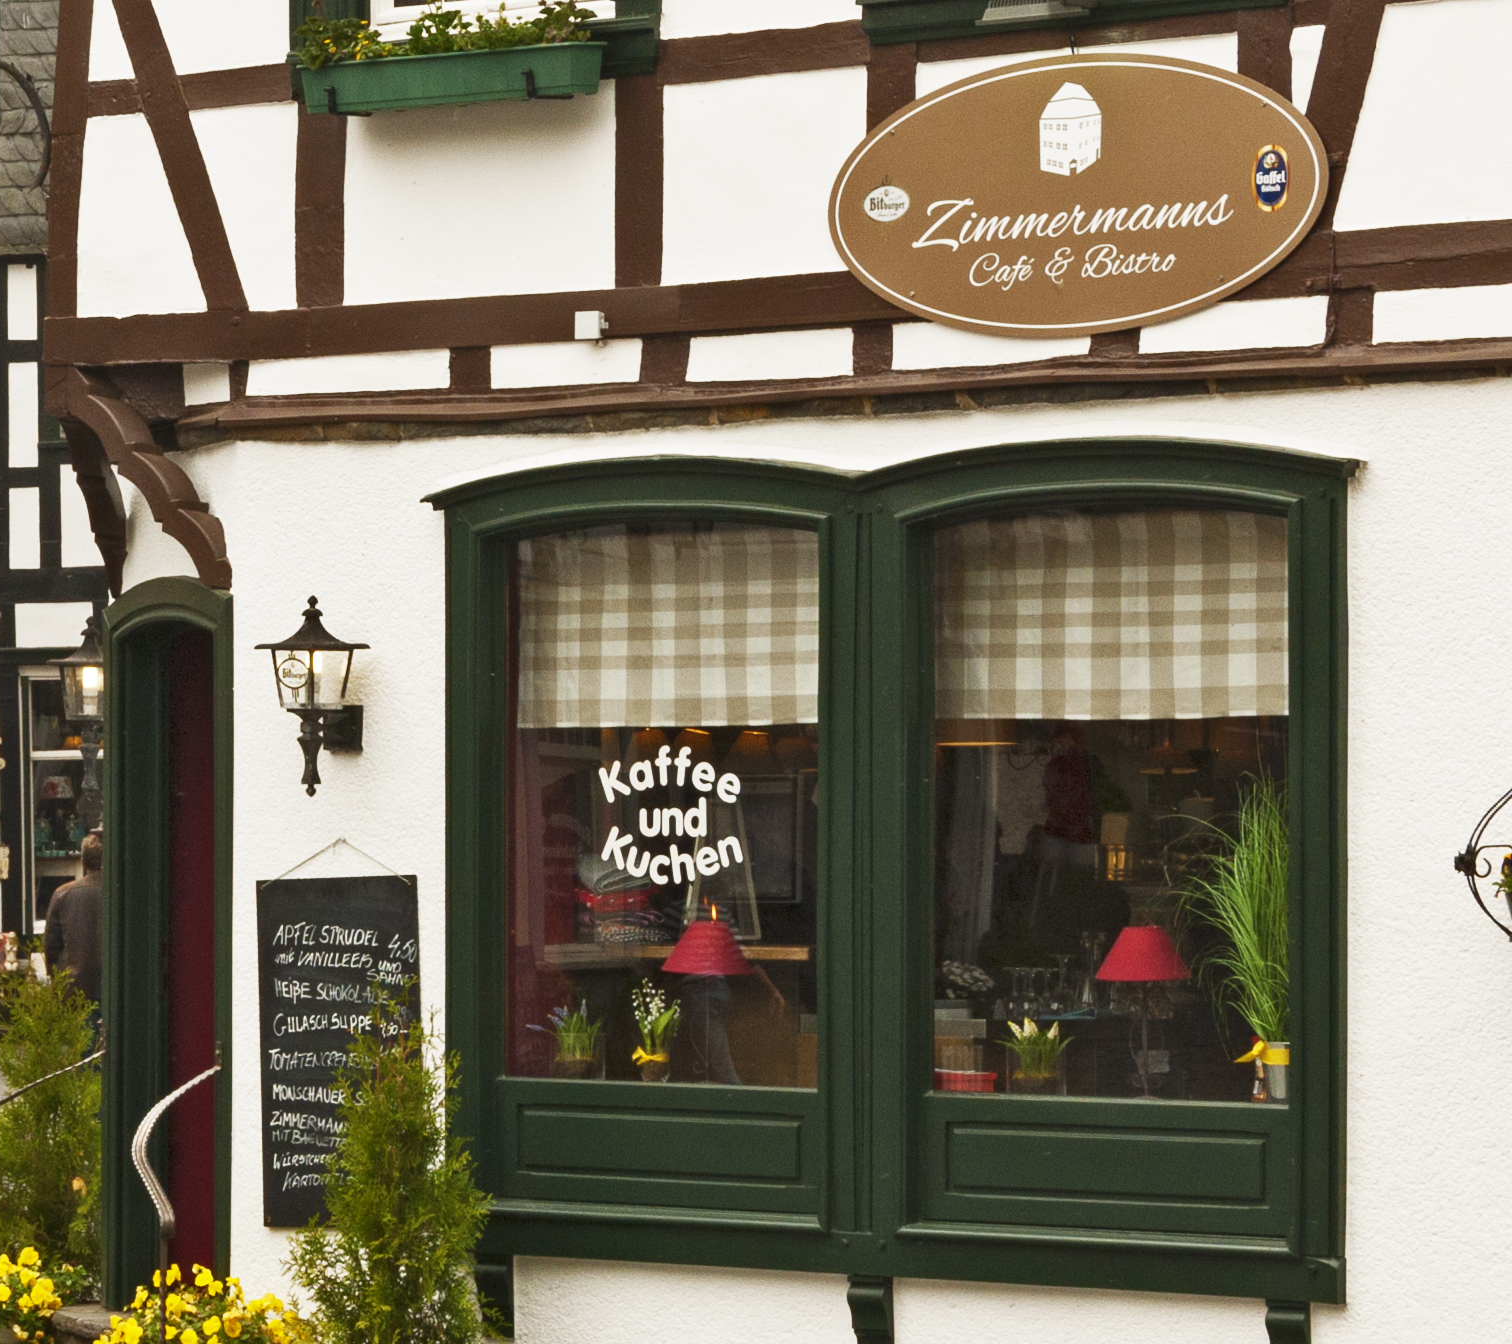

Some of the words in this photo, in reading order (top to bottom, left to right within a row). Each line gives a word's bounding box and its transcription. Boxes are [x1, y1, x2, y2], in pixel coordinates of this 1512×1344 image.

[911, 193, 1234, 251] Zimmermanns
[968, 252, 1034, 291] Café
[1044, 246, 1073, 284] &
[1080, 243, 1177, 280] Bistro
[598, 745, 741, 803] Kaffee
[639, 796, 707, 837] und
[601, 826, 743, 885] Kuchen
[273, 921, 317, 947] APFEL
[319, 924, 379, 947] STRUDEL
[387, 933, 418, 963] 4,50
[272, 1083, 347, 1105] MONSCHAUER
